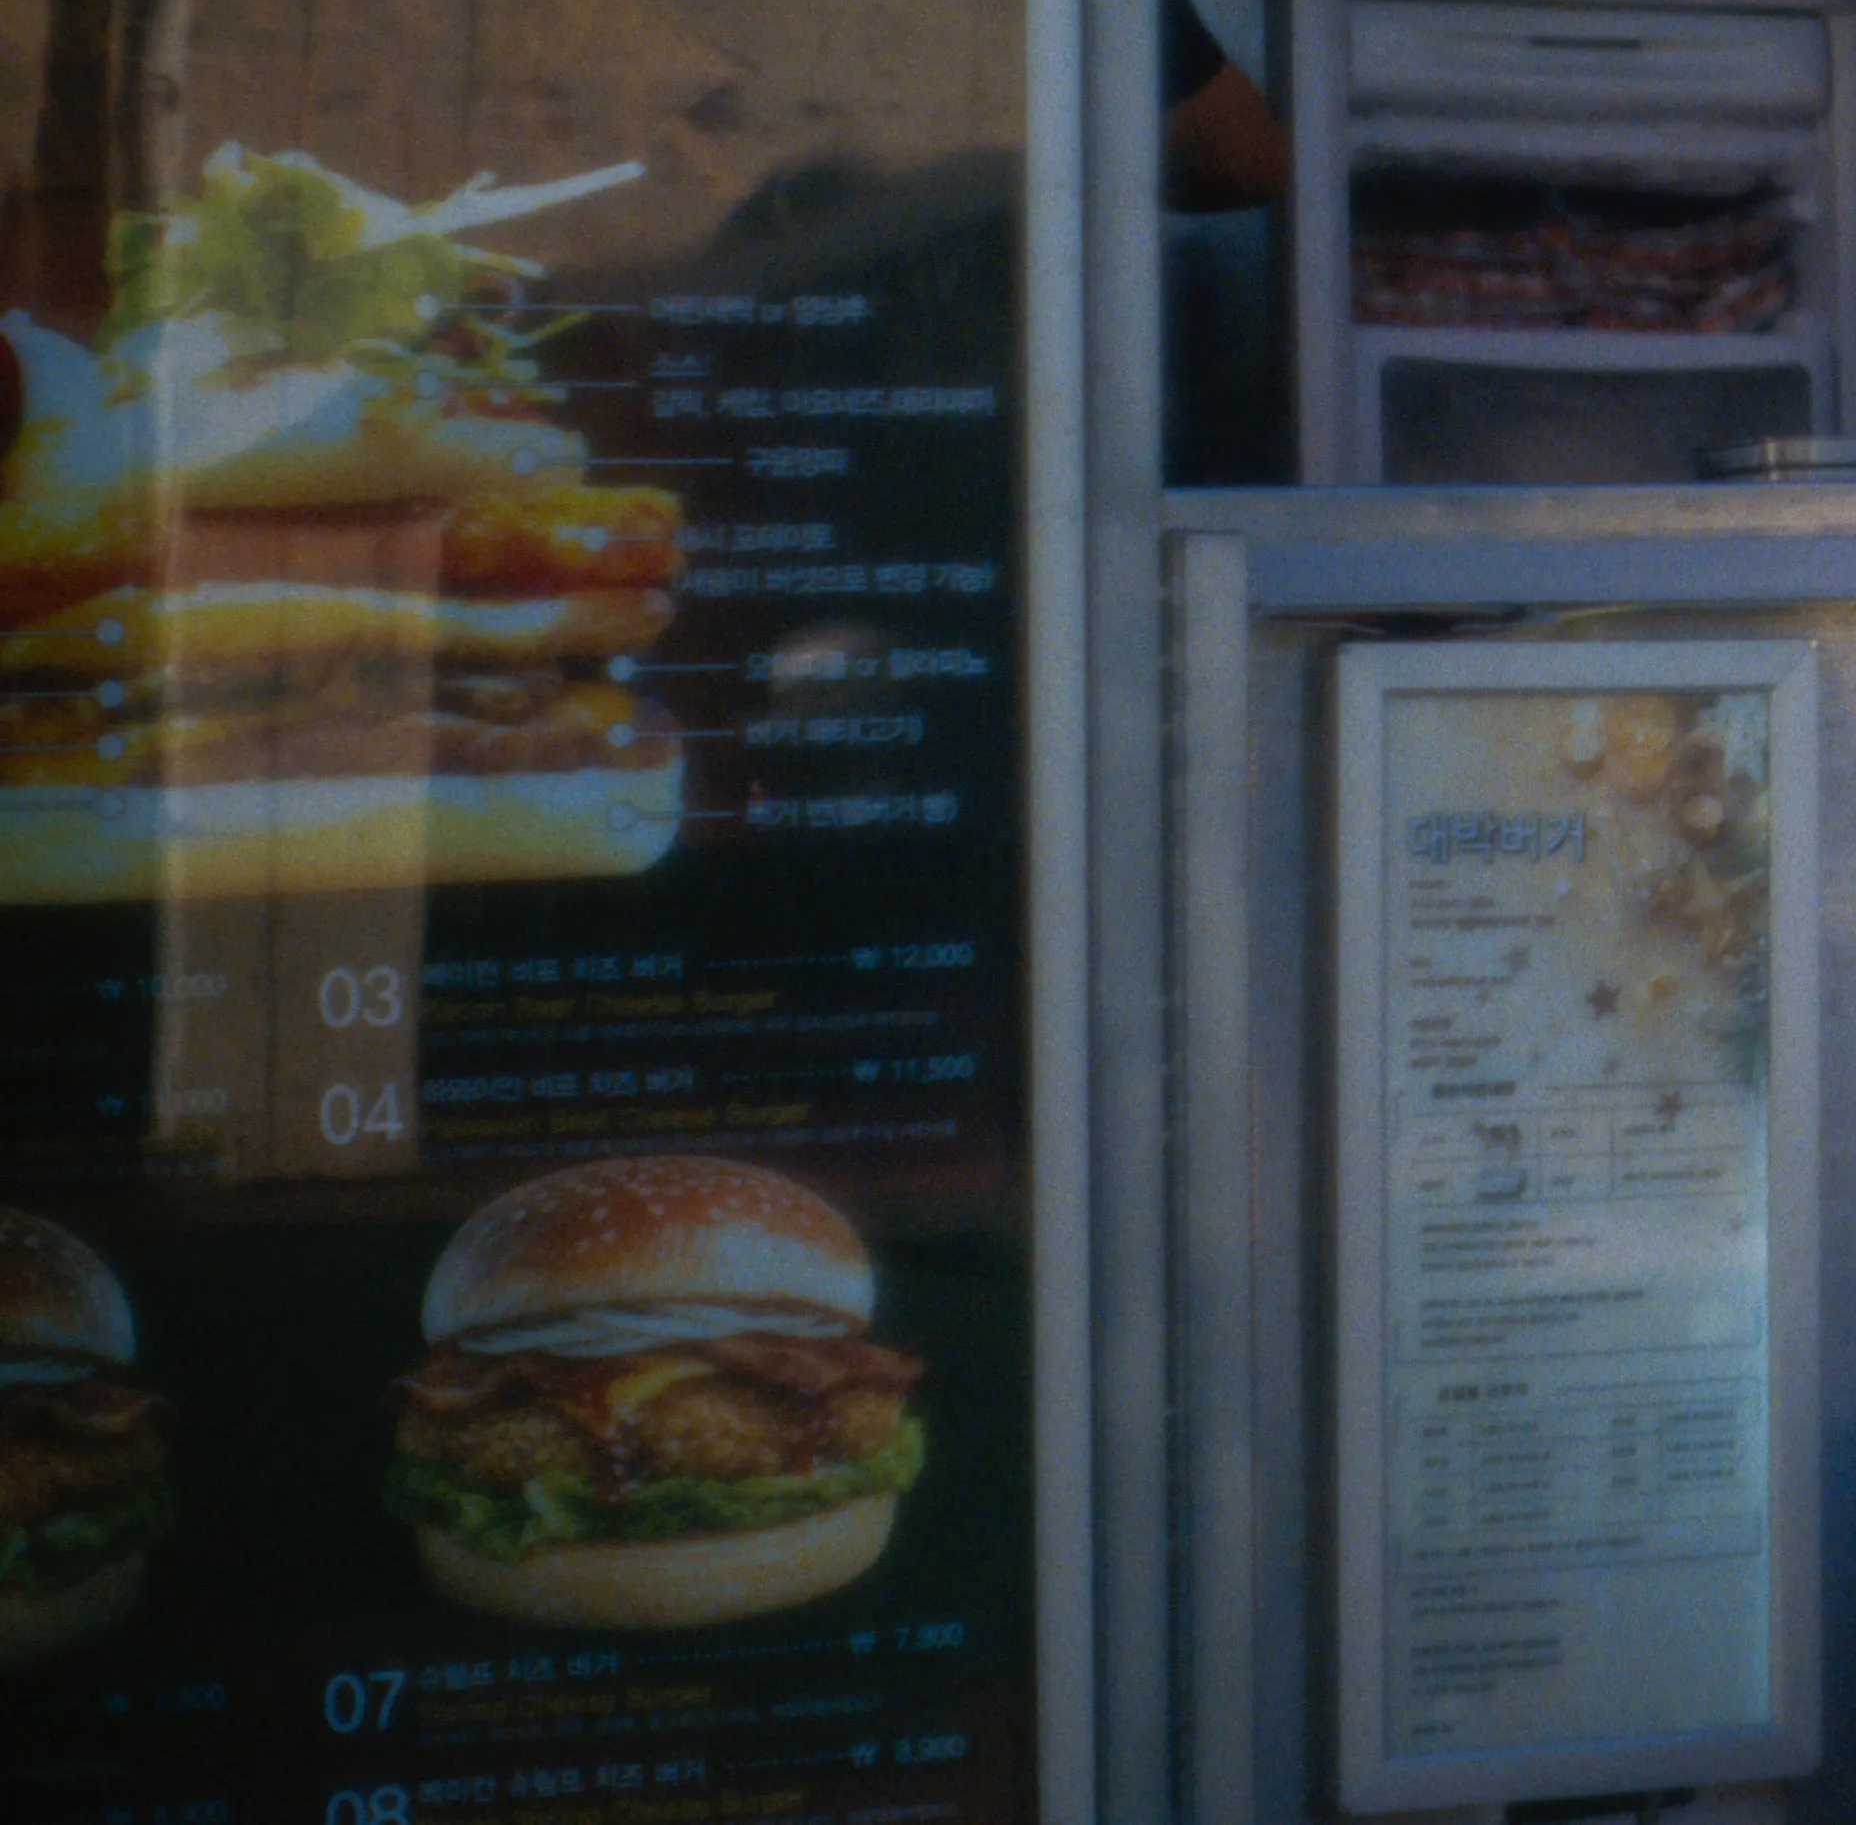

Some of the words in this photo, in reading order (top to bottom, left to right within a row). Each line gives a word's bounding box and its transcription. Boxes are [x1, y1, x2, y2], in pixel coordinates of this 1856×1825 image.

[319, 965, 403, 1031] 03
[319, 1082, 404, 1147] 04
[323, 1669, 407, 1735] 07
